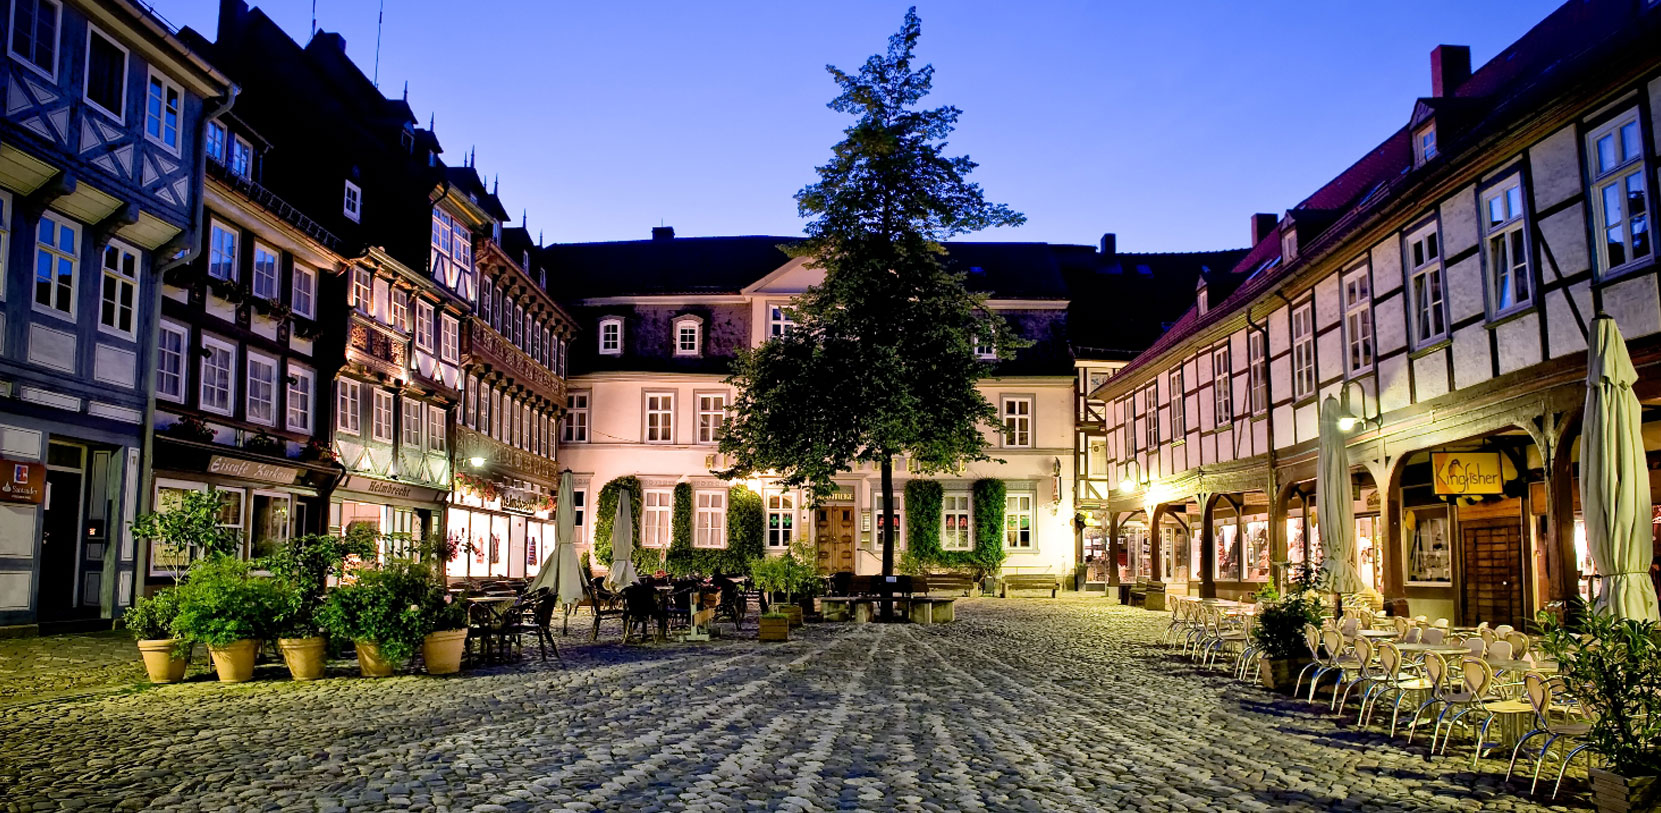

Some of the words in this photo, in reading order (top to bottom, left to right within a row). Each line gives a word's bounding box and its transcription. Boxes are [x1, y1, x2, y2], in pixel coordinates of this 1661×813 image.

[210, 458, 249, 475] Eiscafé
[1435, 462, 1498, 493] Kingfisher
[368, 481, 411, 497] Helmbrecht
